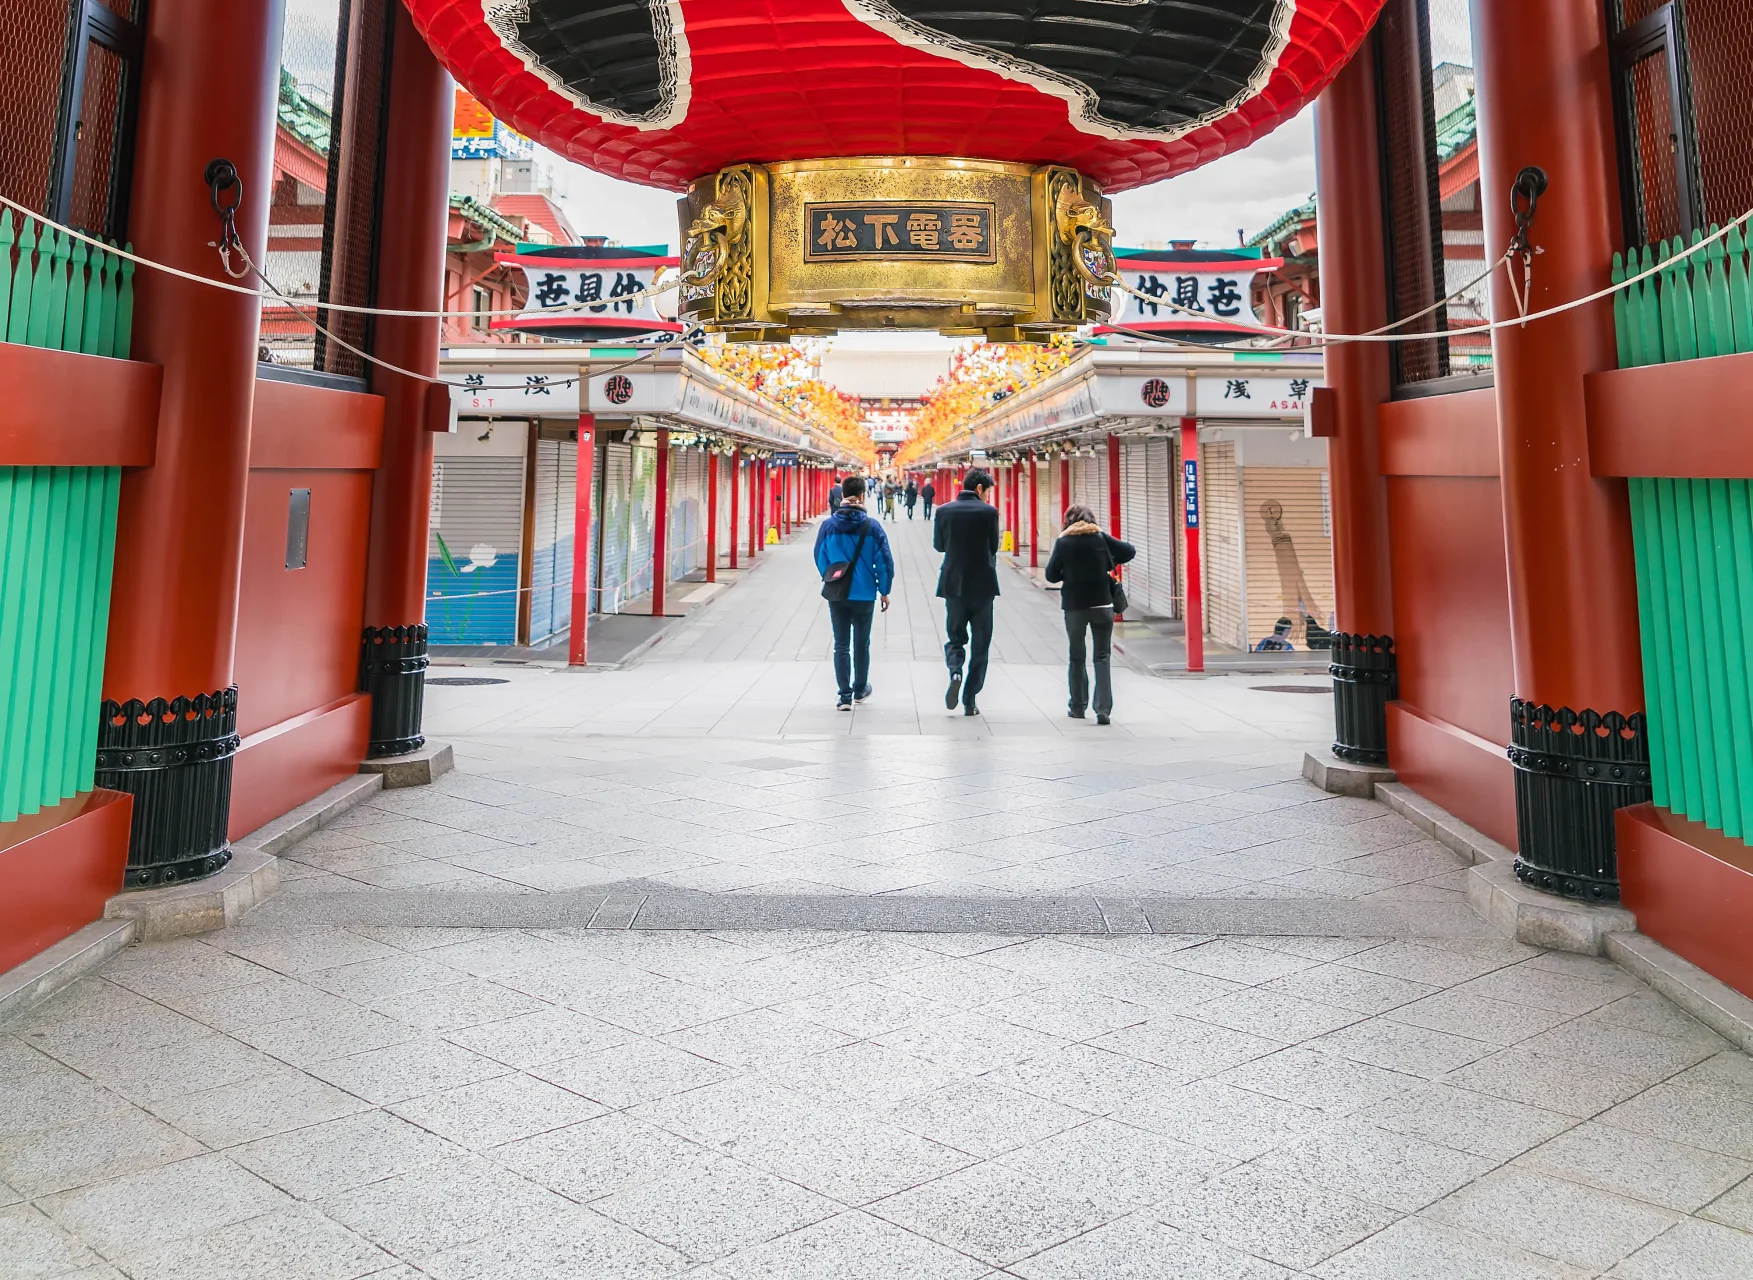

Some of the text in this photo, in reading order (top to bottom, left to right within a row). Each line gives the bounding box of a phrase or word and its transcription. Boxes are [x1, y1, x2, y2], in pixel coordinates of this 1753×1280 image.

[817, 213, 984, 250] 松下電器
[1187, 514, 1197, 523] 18
